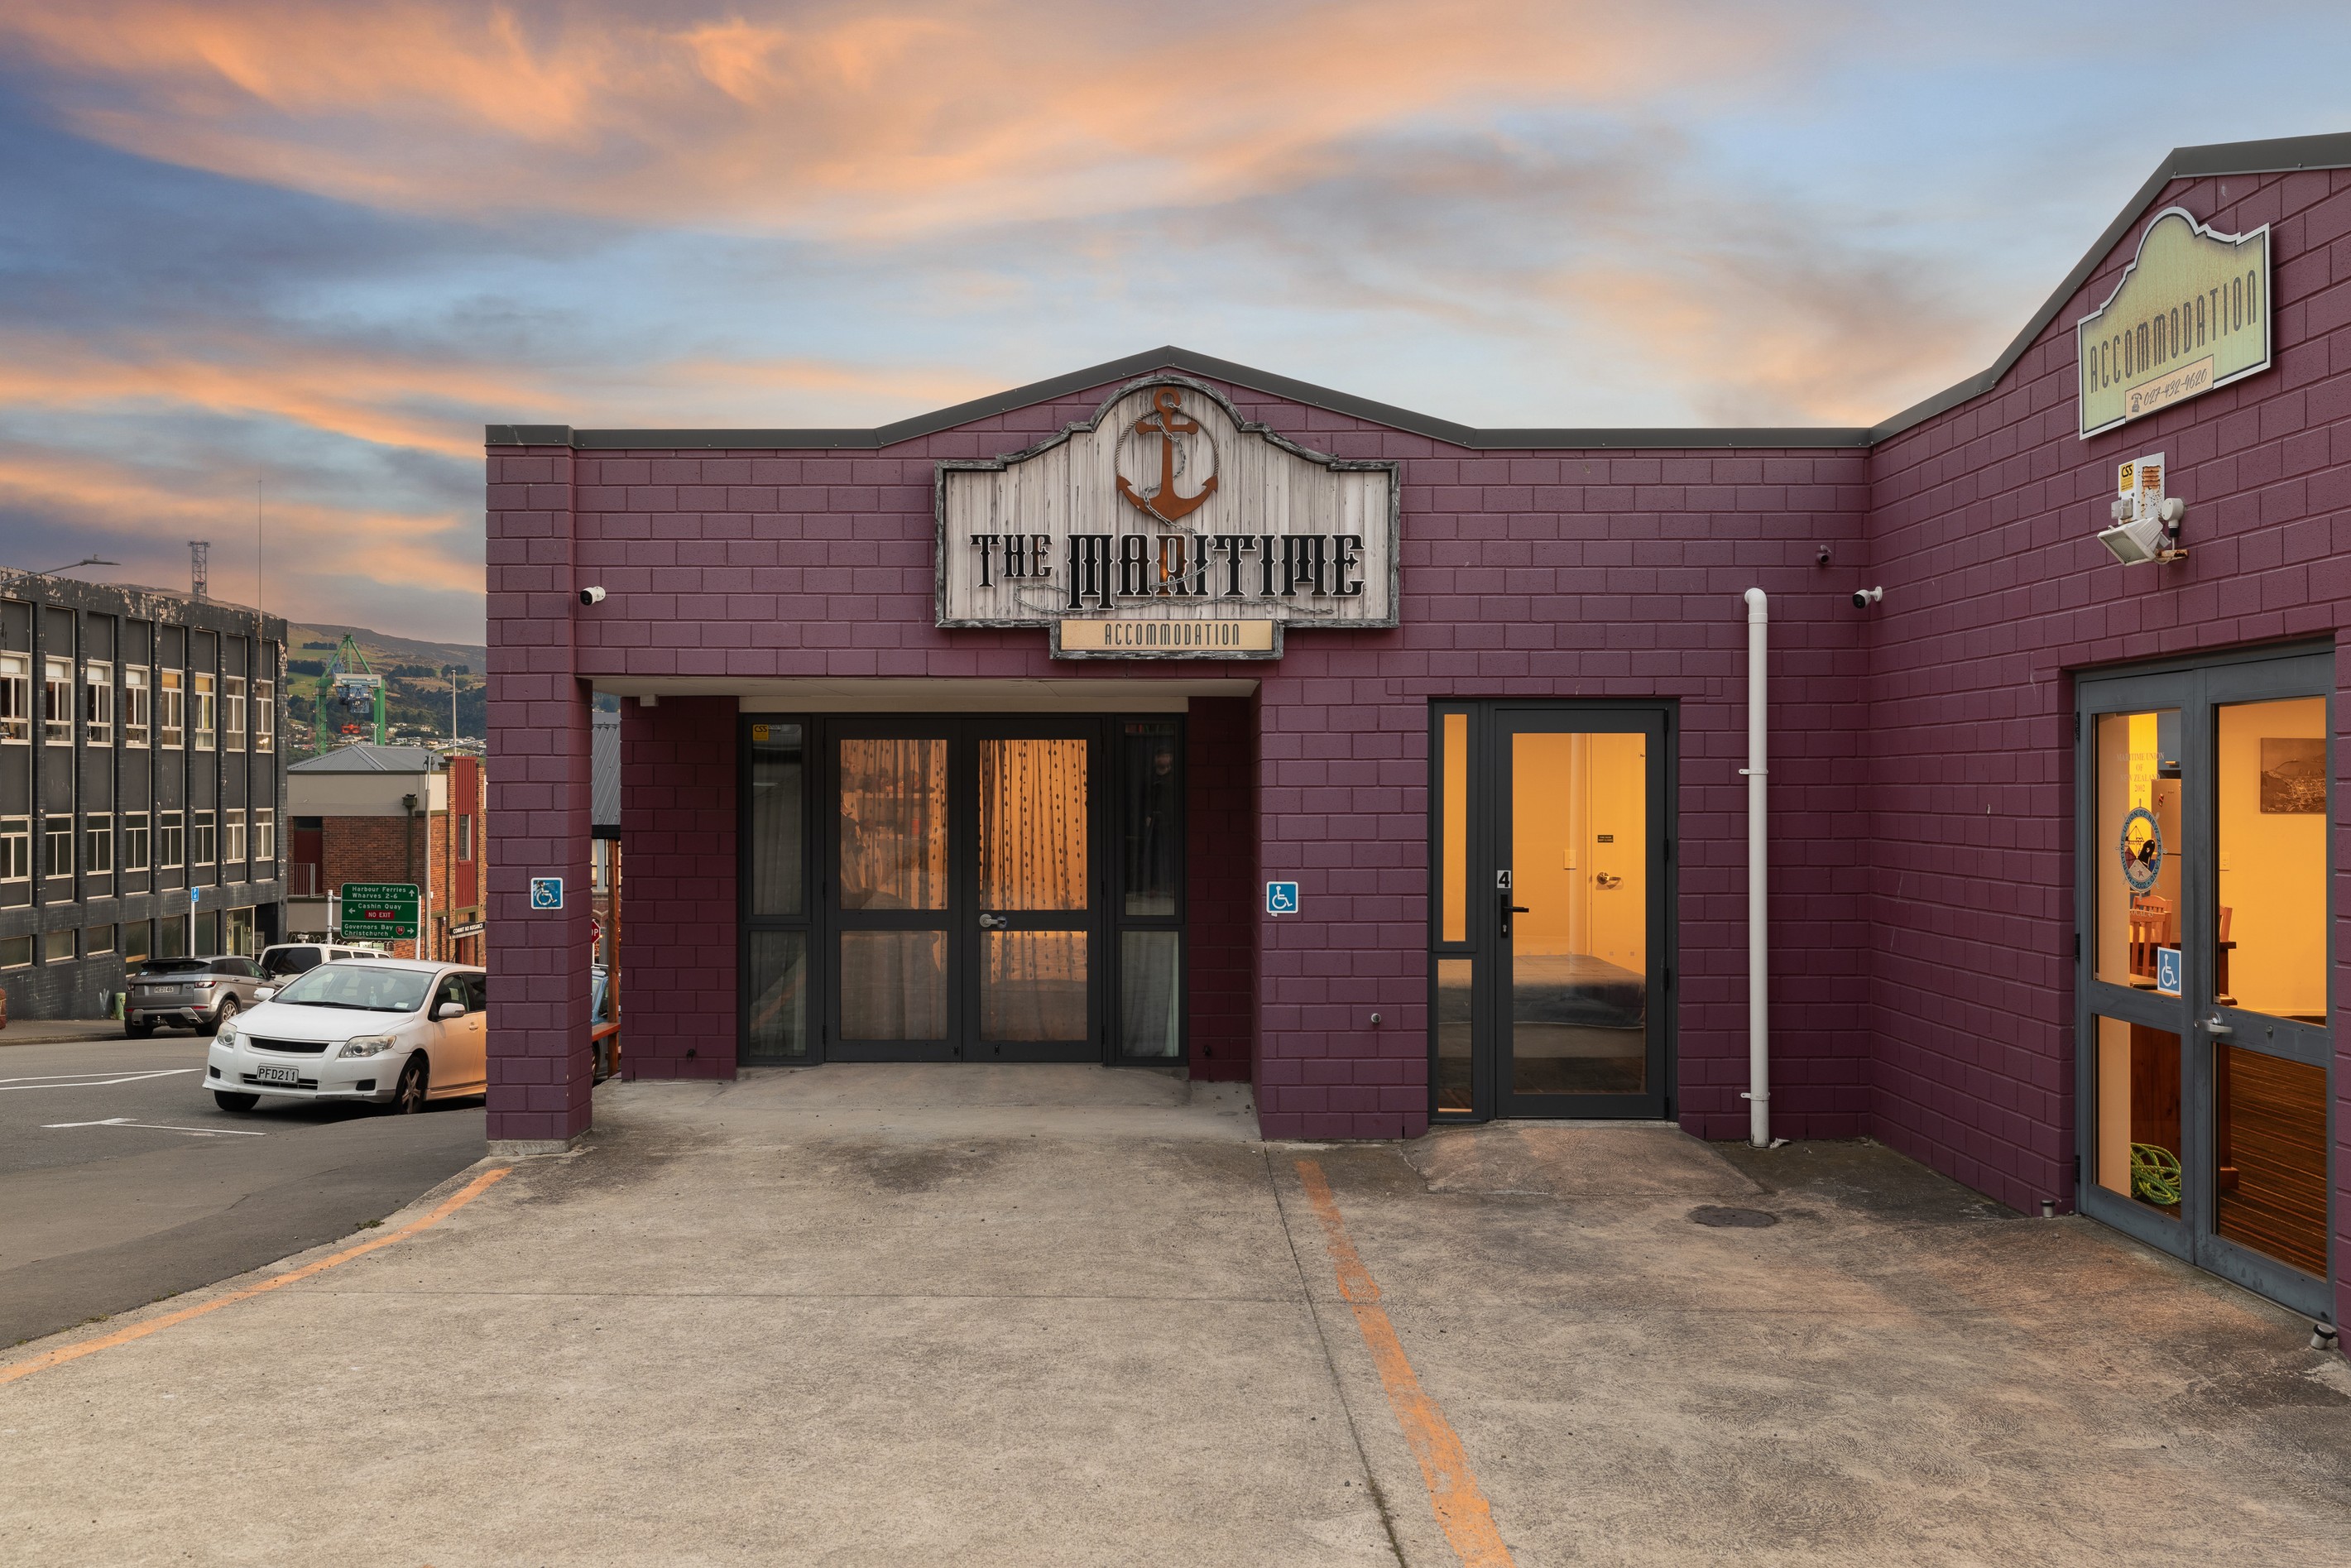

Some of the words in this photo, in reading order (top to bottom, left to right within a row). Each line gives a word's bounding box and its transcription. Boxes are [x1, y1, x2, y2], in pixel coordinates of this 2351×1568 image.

[2090, 270, 2257, 394] ACCOMMODATION
[2121, 464, 2133, 478] CSS
[970, 533, 1053, 588] THE
[1066, 533, 1365, 611] MARITIME
[1105, 623, 1240, 646] ACCOMMODATION
[754, 725, 768, 733] CSS
[1498, 870, 1510, 888] 4
[258, 1068, 295, 1081] PFD211
